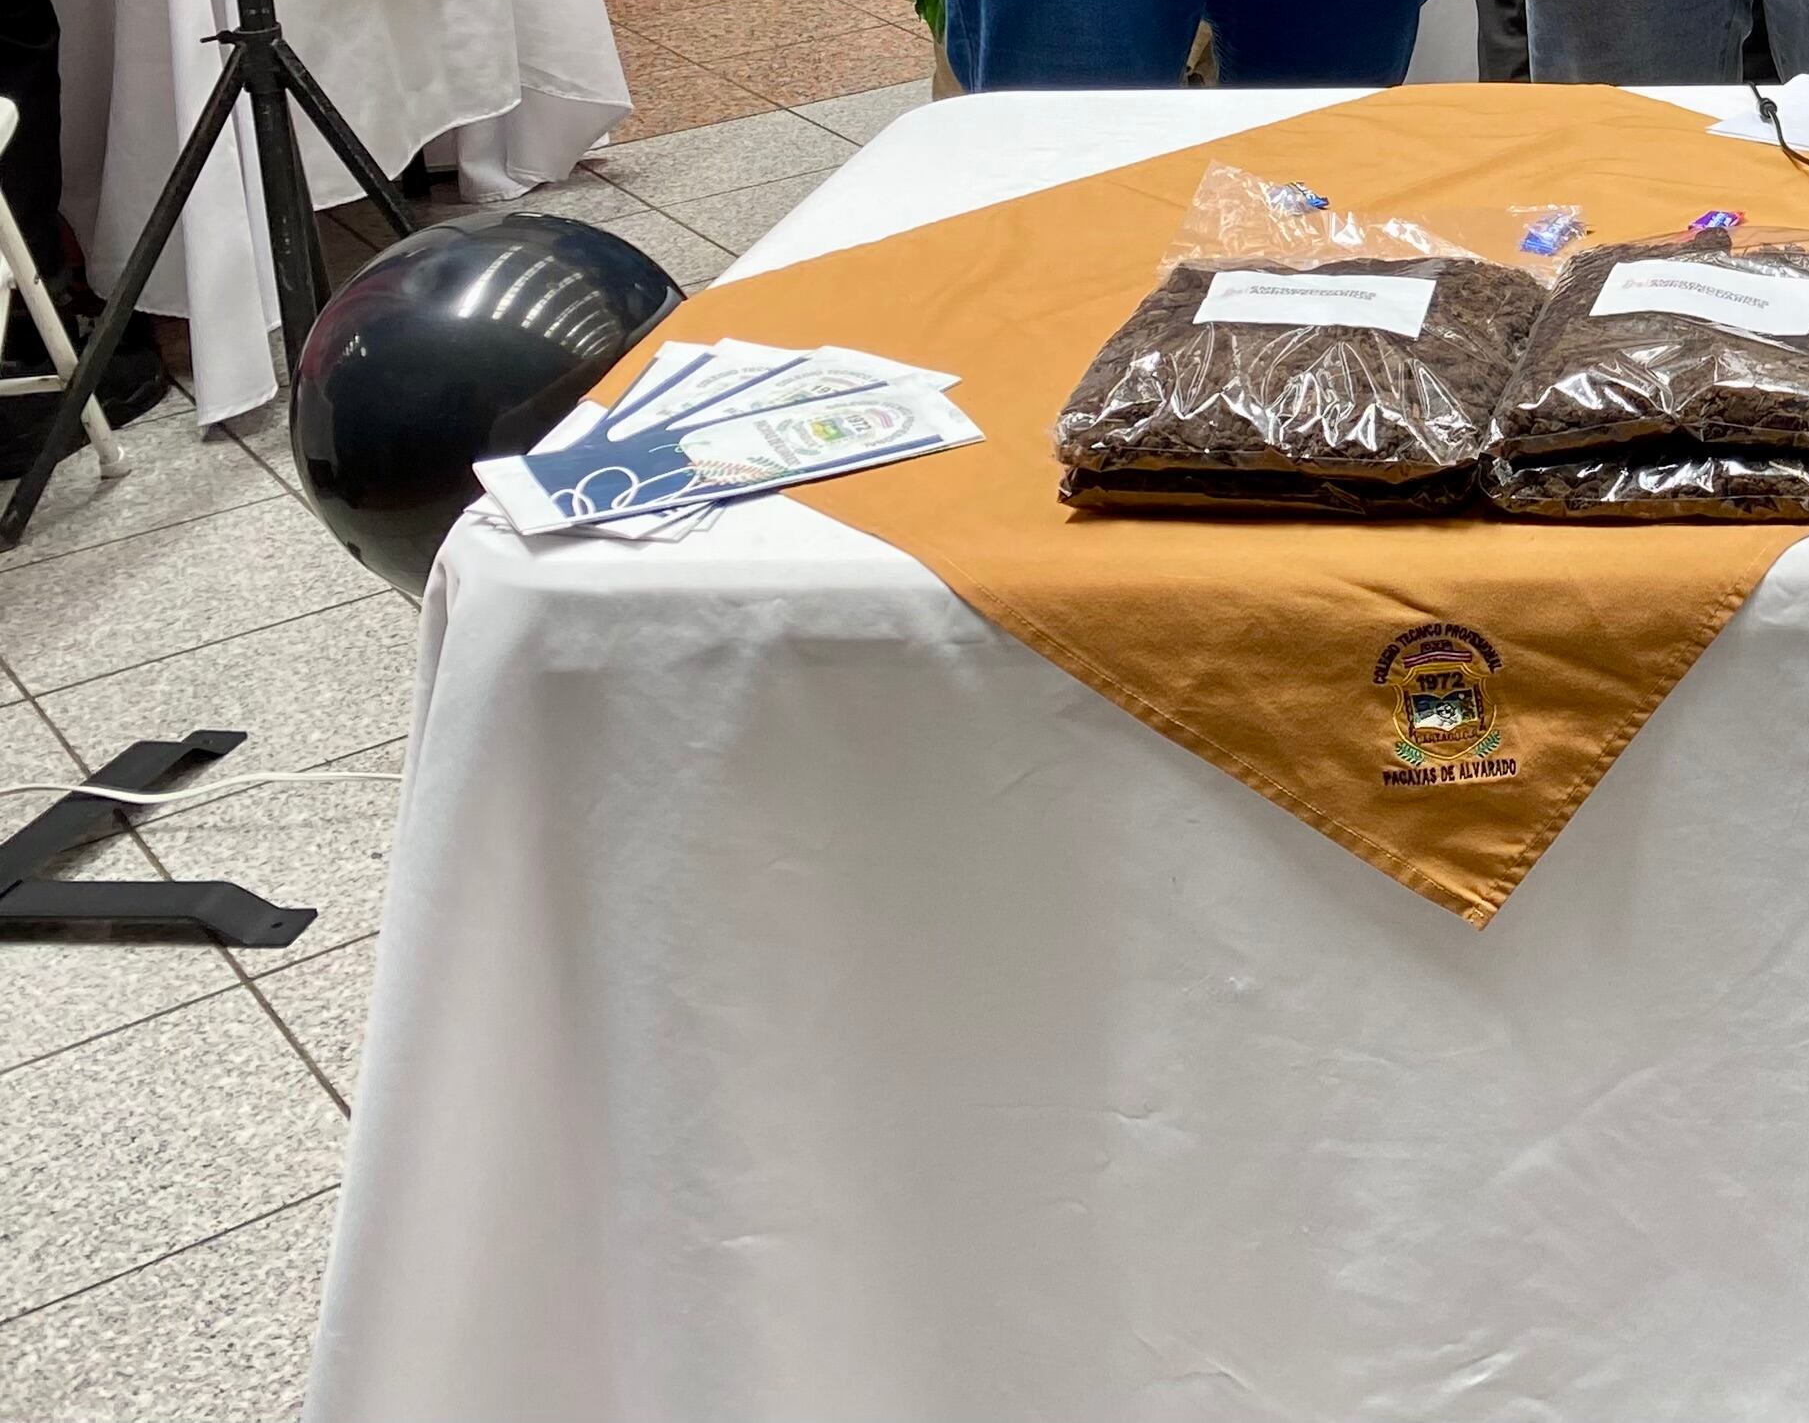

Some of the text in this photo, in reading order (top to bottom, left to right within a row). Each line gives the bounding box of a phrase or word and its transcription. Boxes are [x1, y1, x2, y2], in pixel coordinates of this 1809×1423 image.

[1373, 643, 1400, 684] COLEGIO
[1395, 623, 1442, 647] TECNICO
[1415, 671, 1466, 692] 1972
[1382, 758, 1517, 787] PACAYAS DE ALVARADO
